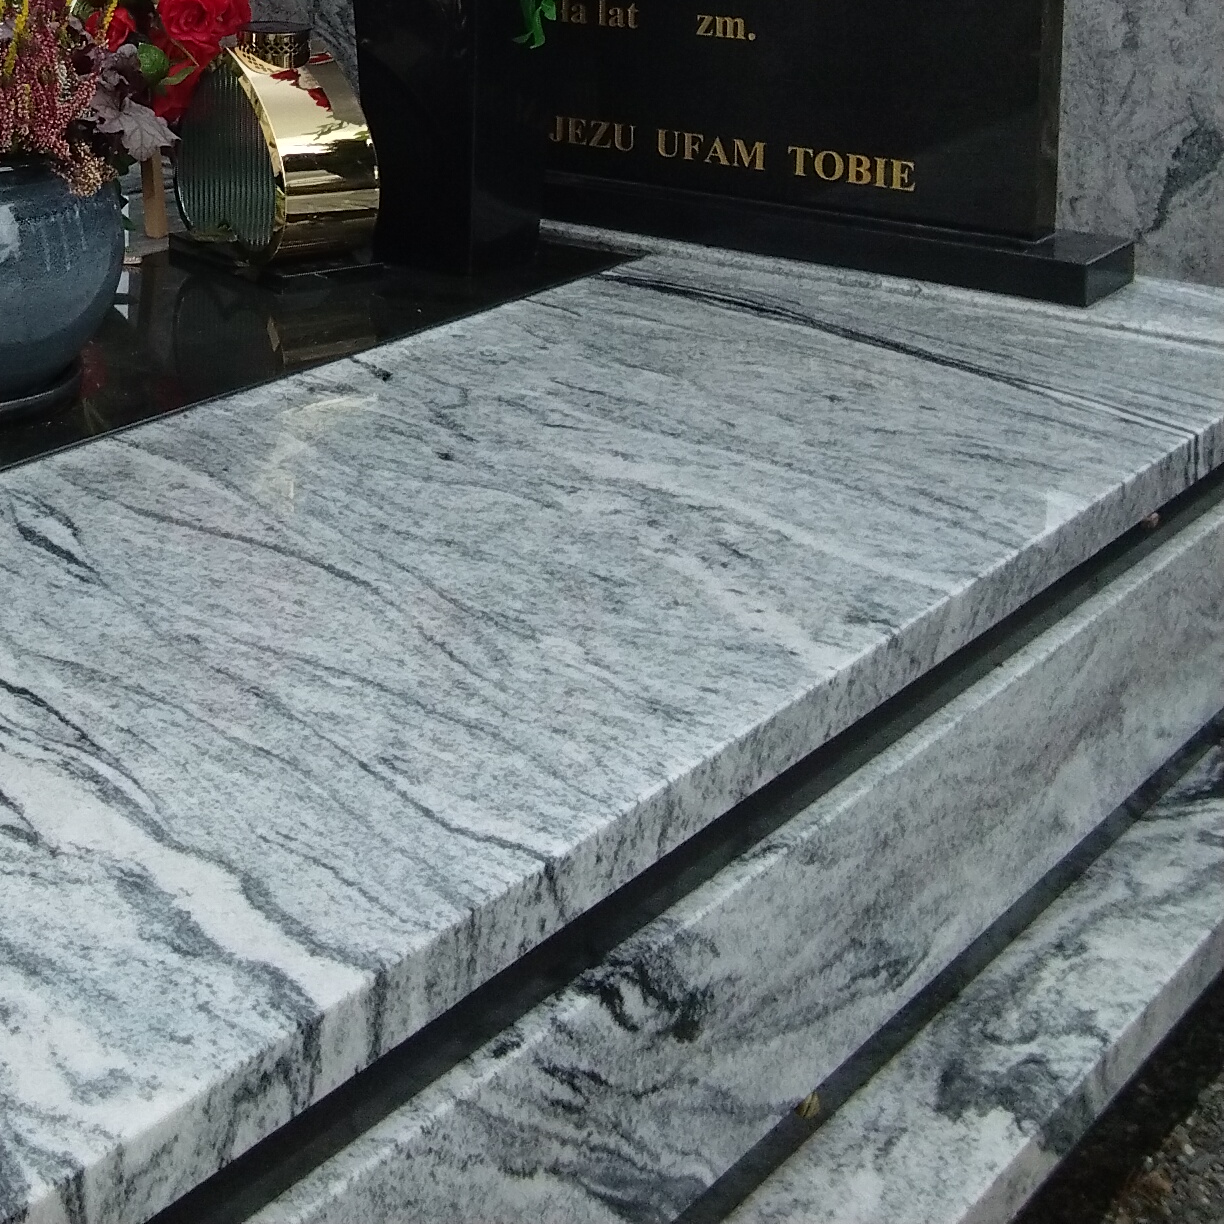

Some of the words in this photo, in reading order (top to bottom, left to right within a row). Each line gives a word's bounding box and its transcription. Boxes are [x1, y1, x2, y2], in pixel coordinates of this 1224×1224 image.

[696, 13, 756, 41] zm.
[549, 115, 636, 152] JEZU
[657, 128, 766, 171] UFAM
[787, 145, 916, 192] TOBIE
